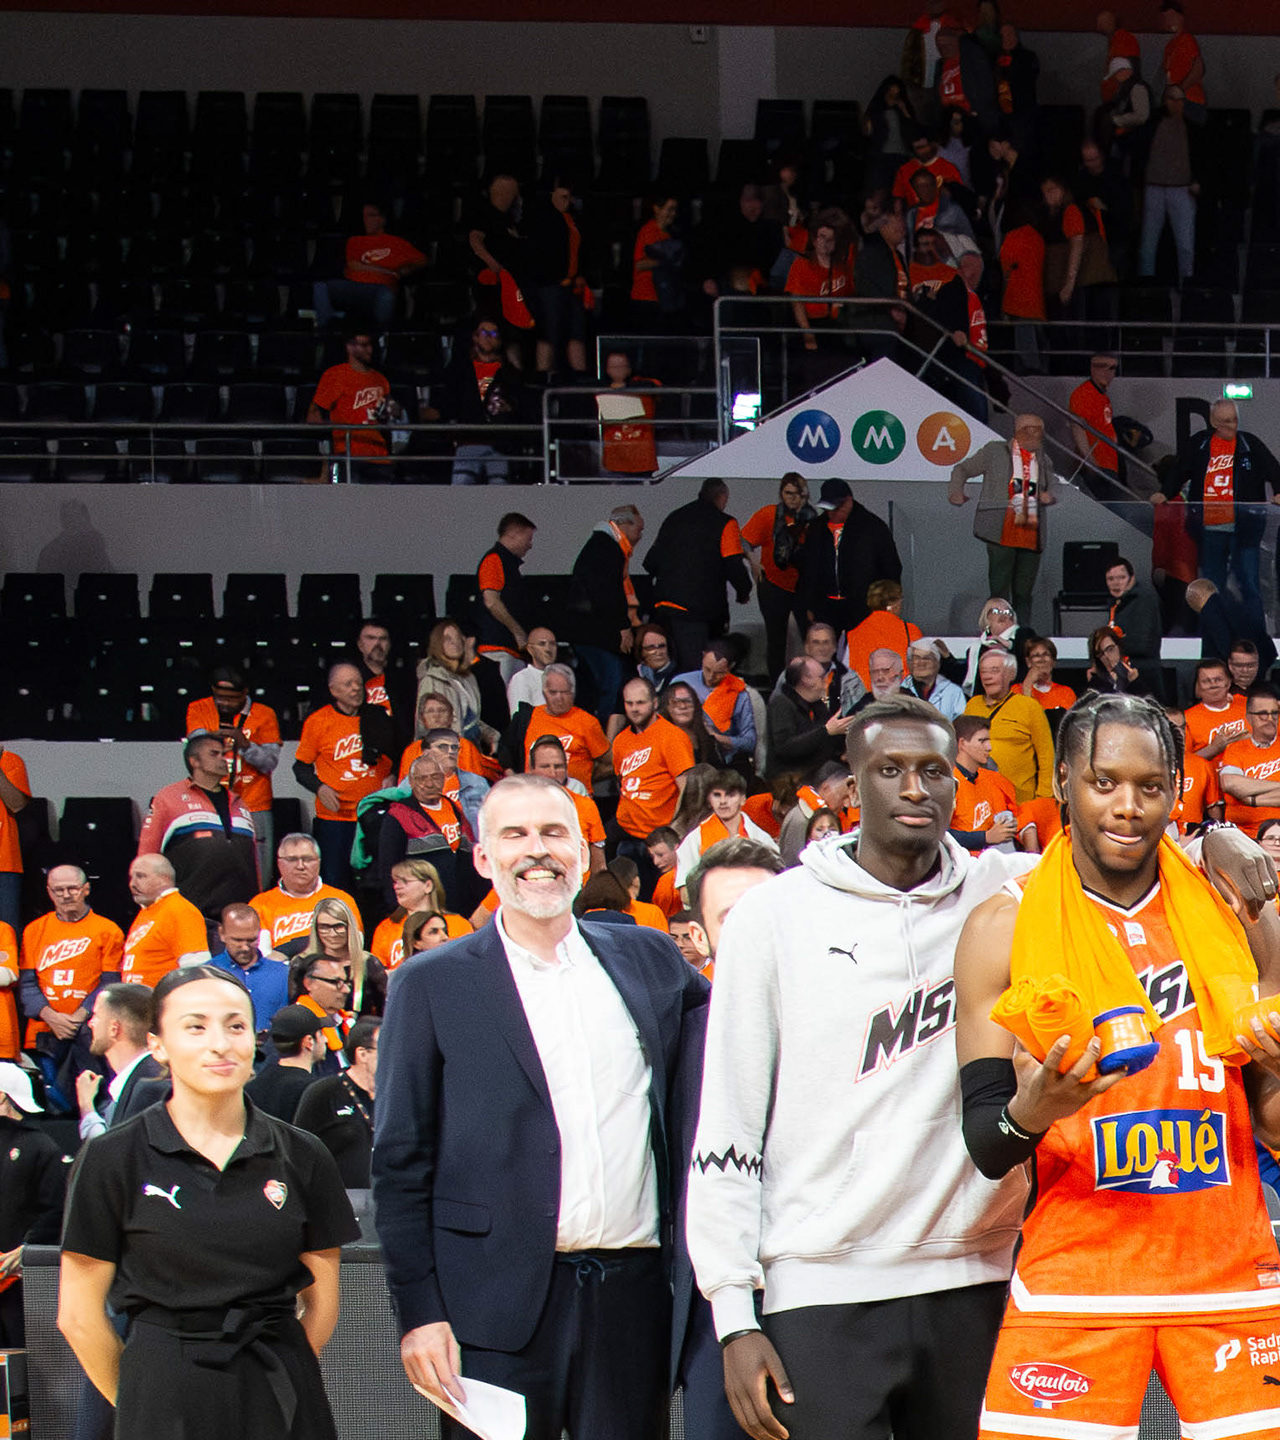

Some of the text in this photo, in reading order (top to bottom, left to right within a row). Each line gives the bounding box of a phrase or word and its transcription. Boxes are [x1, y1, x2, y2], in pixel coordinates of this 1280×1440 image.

[334, 733, 363, 761] MS
[40, 937, 92, 971] MSB
[856, 974, 956, 1082] MS
[1102, 1108, 1222, 1178] Loué
[1011, 1366, 1090, 1396] le Gaulois
